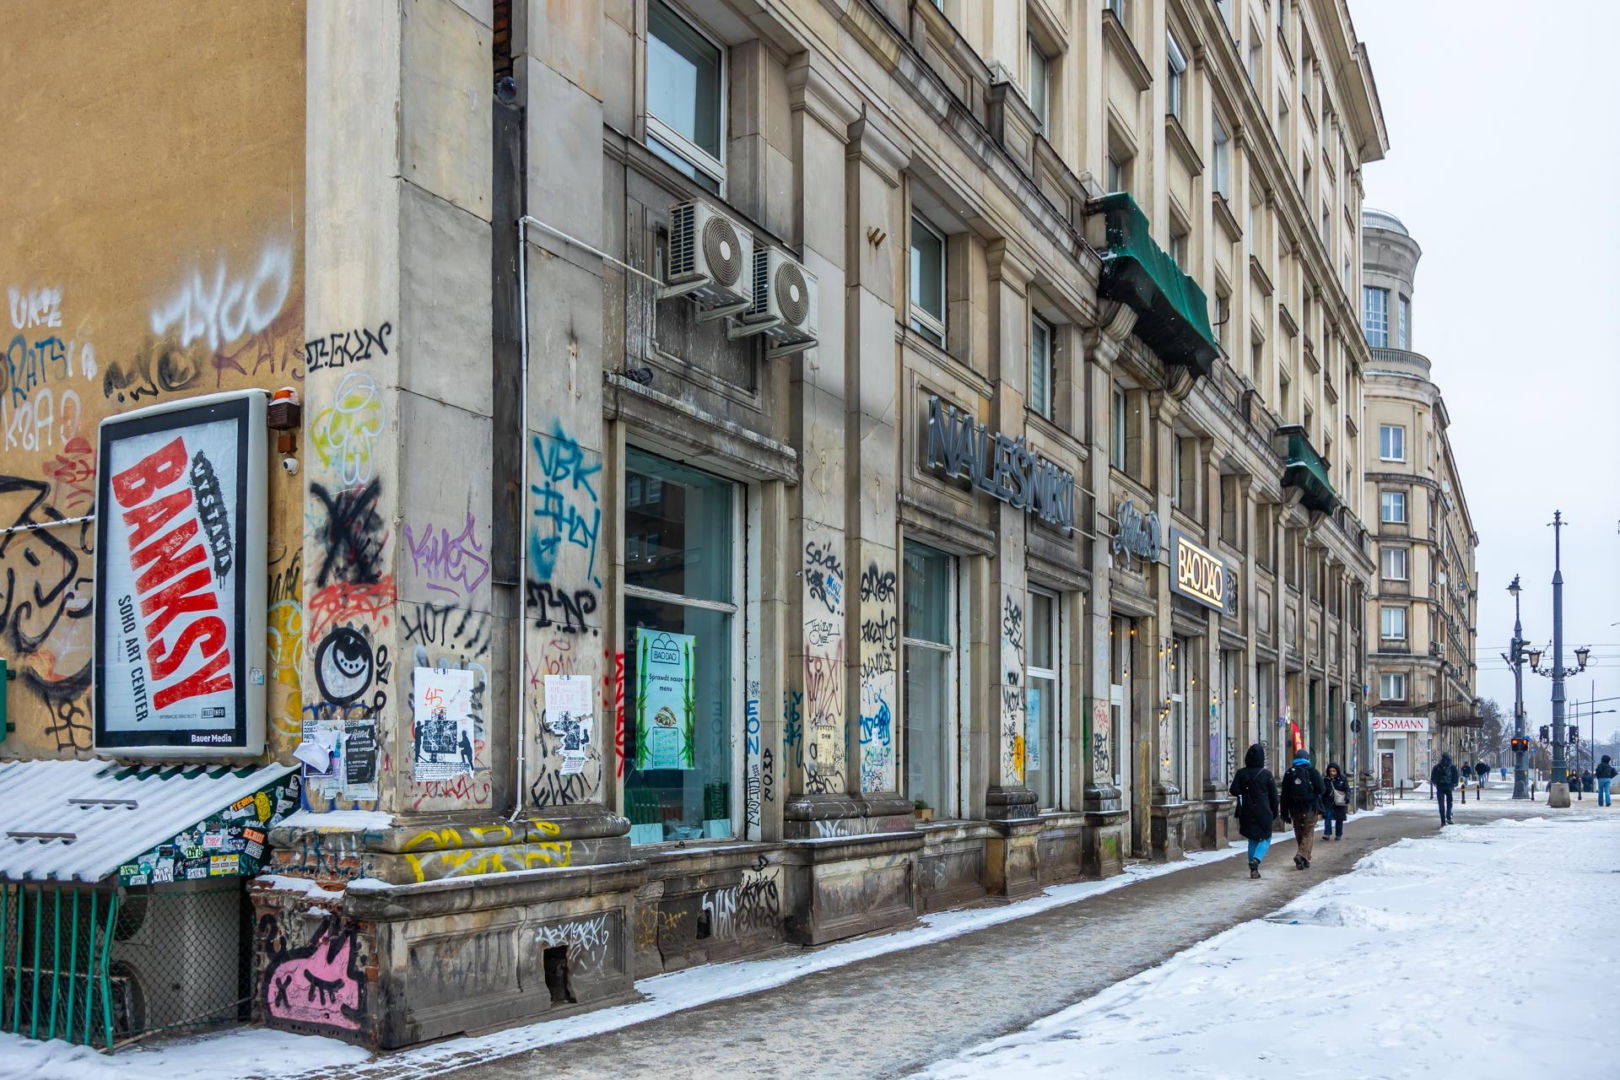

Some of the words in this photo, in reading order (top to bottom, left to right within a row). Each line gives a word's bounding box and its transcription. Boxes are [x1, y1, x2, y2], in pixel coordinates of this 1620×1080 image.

[194, 461, 230, 567] WYSTAWA
[111, 435, 233, 711] BANKSY
[1178, 545, 1201, 590] BAO
[1202, 558, 1223, 601] DAO
[118, 594, 136, 634] SOHO
[125, 637, 142, 663] ART
[653, 651, 665, 660] BAO
[131, 667, 149, 722] CENTER
[191, 734, 211, 742] Bauer
[211, 734, 232, 742] Media
[763, 748, 774, 802] AMOR
